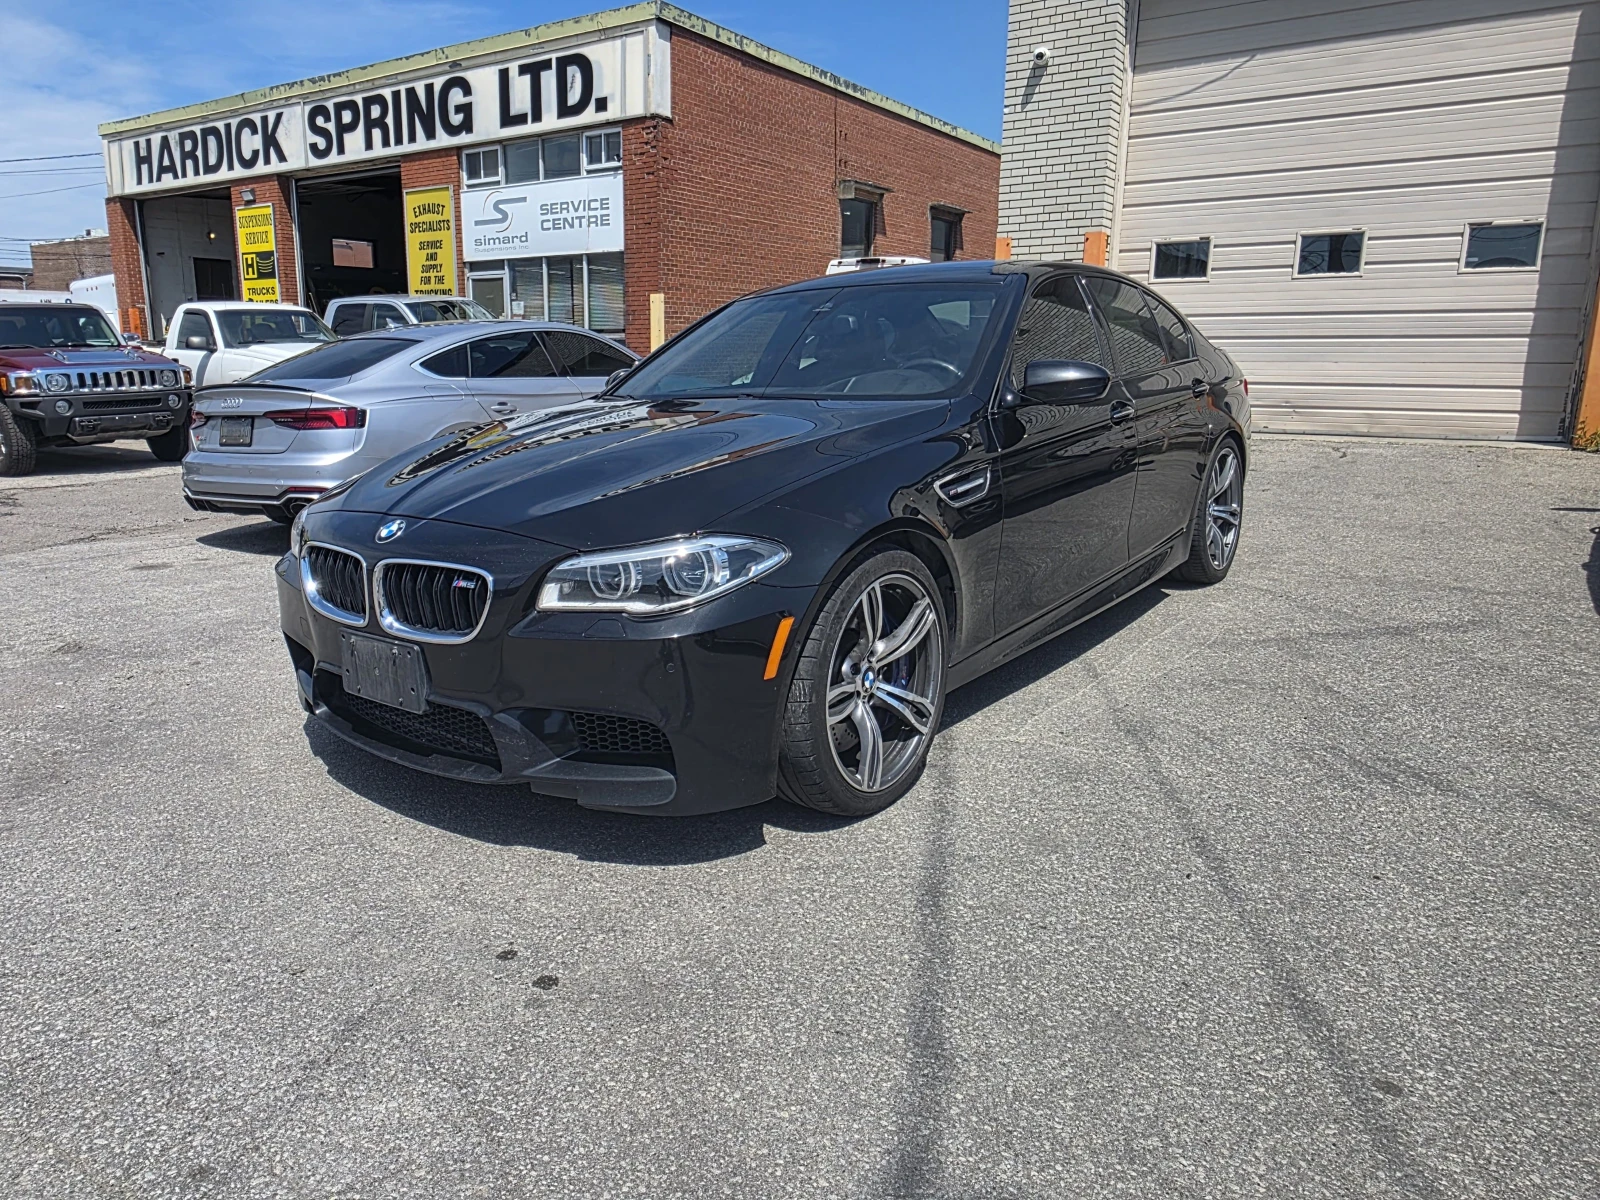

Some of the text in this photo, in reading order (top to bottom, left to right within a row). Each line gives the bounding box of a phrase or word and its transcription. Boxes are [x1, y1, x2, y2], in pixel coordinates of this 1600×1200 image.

[135, 53, 608, 186] HARDICK SPRING LTD.
[413, 203, 446, 218] EXHAUST
[540, 198, 610, 216] SERVICE
[238, 213, 272, 229] SUSPENSIONS
[409, 219, 451, 234] SPECIALISTS
[540, 214, 611, 232] CENTRE
[245, 231, 269, 245] SERVICE
[418, 240, 443, 250] SERVICE
[474, 232, 528, 246] simard
[474, 245, 517, 253] Suspensions
[425, 252, 438, 263] AND
[244, 256, 256, 276] H
[420, 264, 442, 274] SUPPLY
[420, 275, 445, 286] FOR THE
[247, 286, 276, 296] TRUCKS
